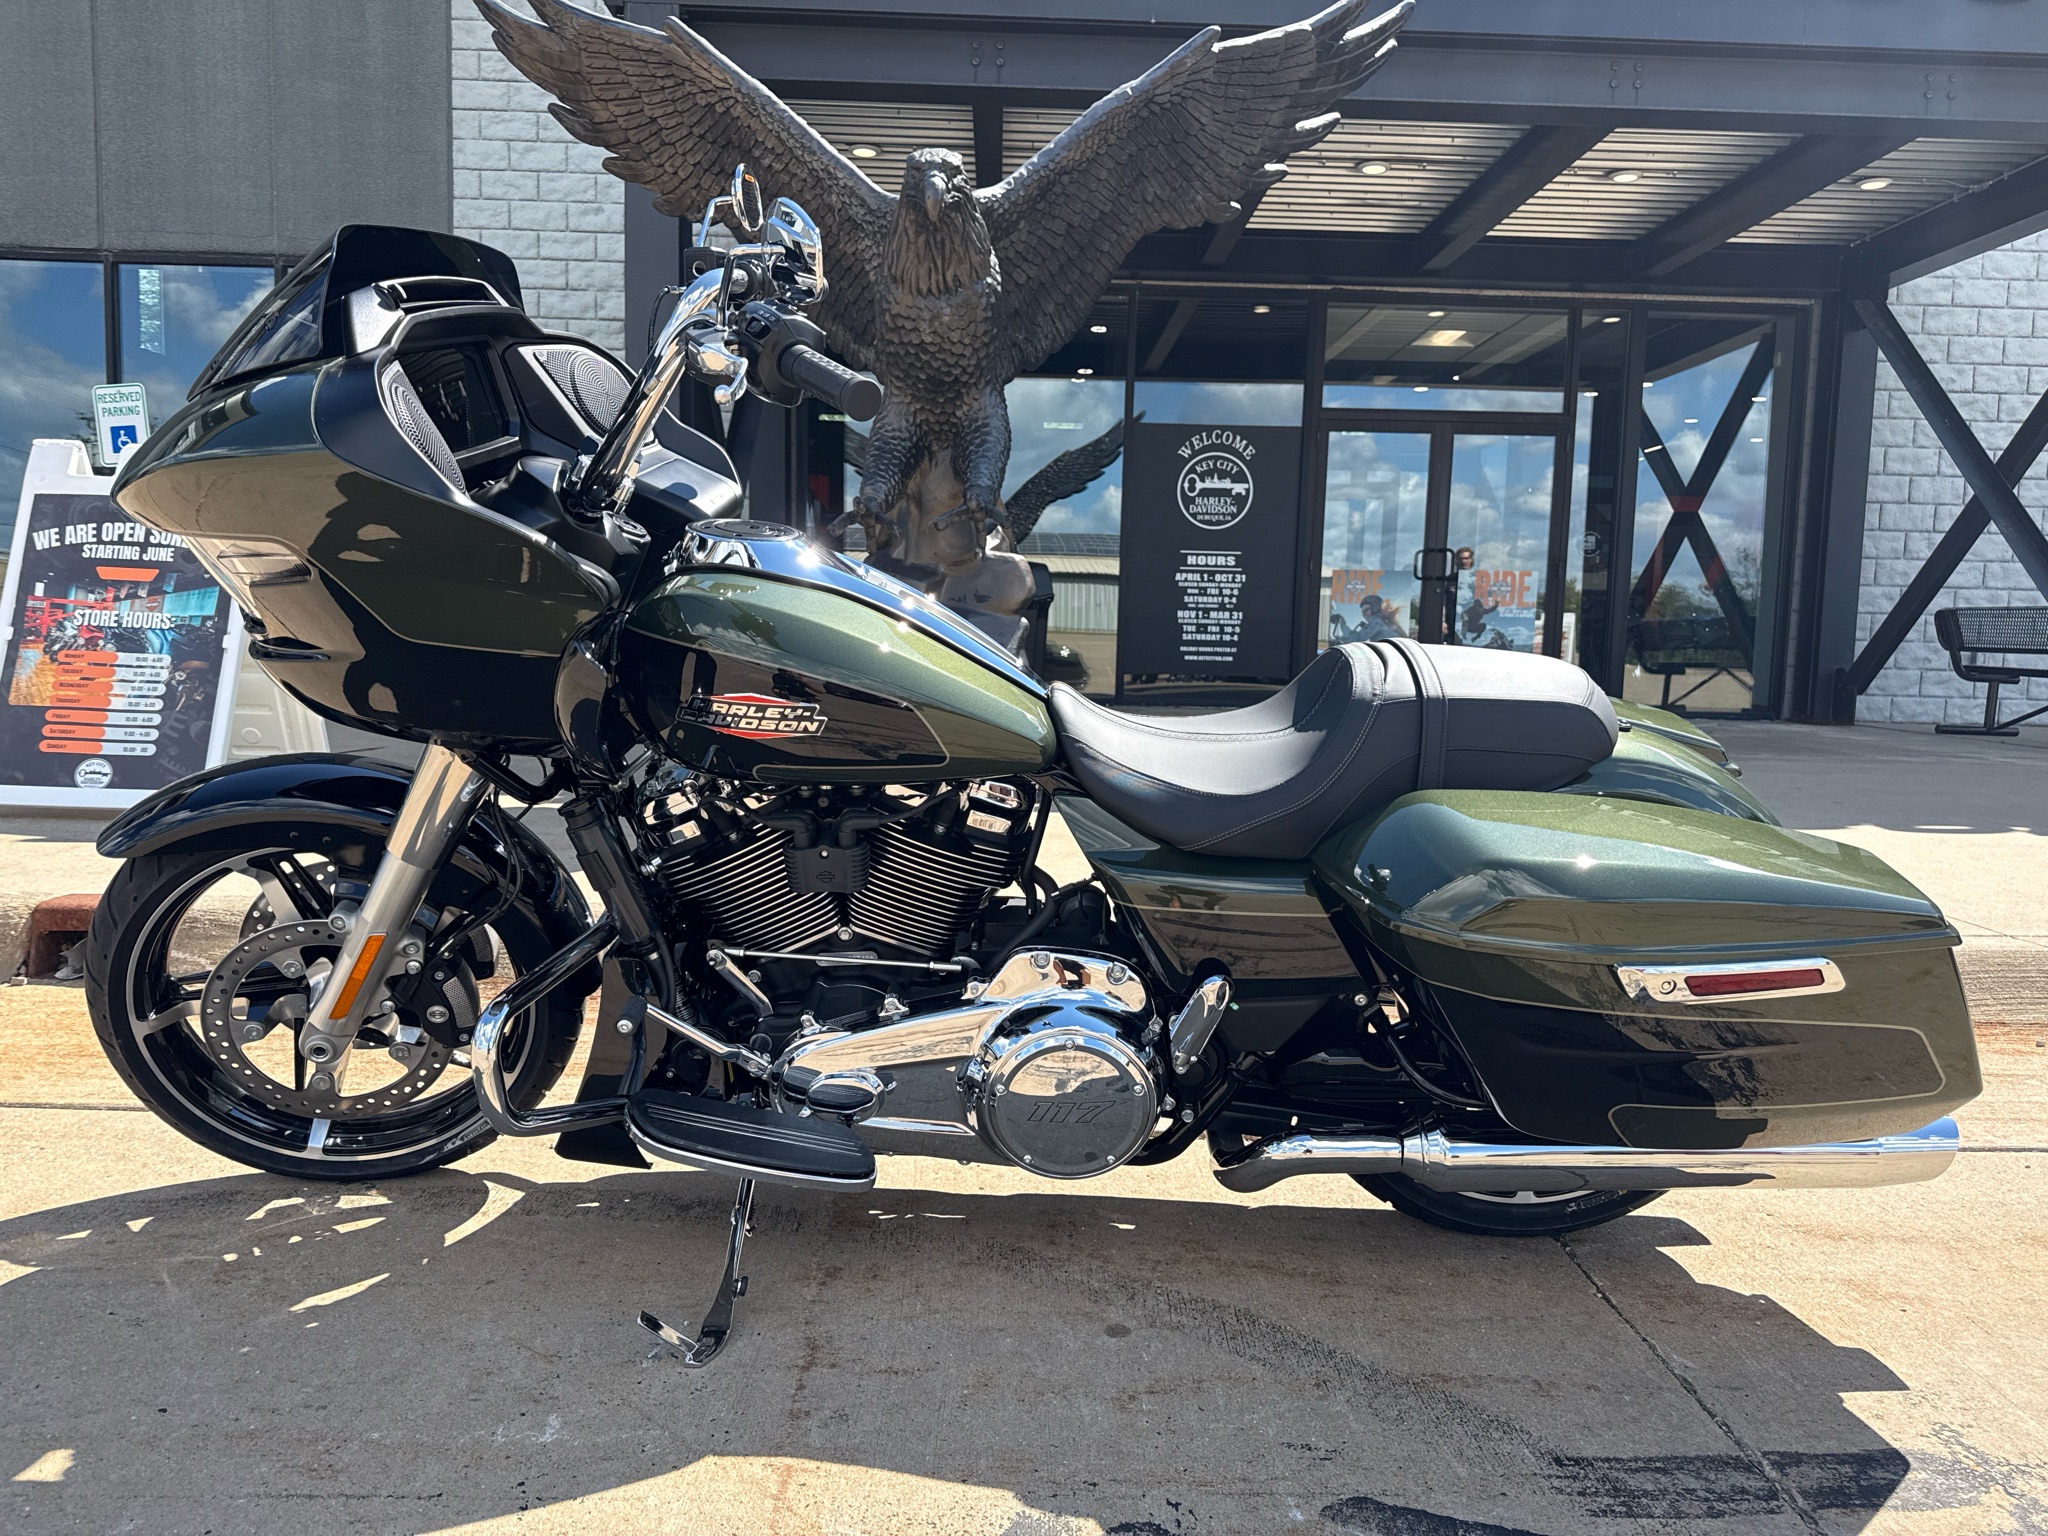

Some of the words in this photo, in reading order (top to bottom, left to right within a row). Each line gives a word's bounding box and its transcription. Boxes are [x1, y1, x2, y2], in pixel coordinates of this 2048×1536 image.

[97, 391, 141, 404] RESERVED
[101, 405, 141, 418] PARKING
[1177, 429, 1256, 460] WELCOME
[1195, 460, 1214, 473] KEY
[1216, 460, 1239, 474] CITY
[1195, 497, 1235, 506] HARLEY-
[1189, 504, 1237, 514] DAVIDSON
[32, 528, 61, 551] WE
[64, 523, 97, 545] ARE
[101, 522, 146, 544] OPEN
[149, 529, 189, 549] SUN
[81, 544, 141, 561] STARTING
[142, 546, 175, 562] JUNE
[1186, 554, 1236, 566] HOURS
[1175, 572, 1202, 581] APRIL
[1203, 573, 1208, 581] 1
[1214, 573, 1233, 582] OCT
[1234, 574, 1246, 582] 31
[1183, 595, 1222, 603] SATURDAY
[1223, 596, 1237, 604] 9-4
[73, 609, 119, 627] STORE
[121, 611, 176, 630] HOURS:
[1177, 610, 1196, 618] NOV
[1197, 610, 1203, 619] 1
[1209, 611, 1230, 619] MAR
[1231, 611, 1243, 620] 31
[1207, 625, 1220, 633] FRI
[1182, 633, 1220, 641] SATURDAY
[680, 708, 820, 732] DAVIDSON
[1027, 1100, 1116, 1124] 117
